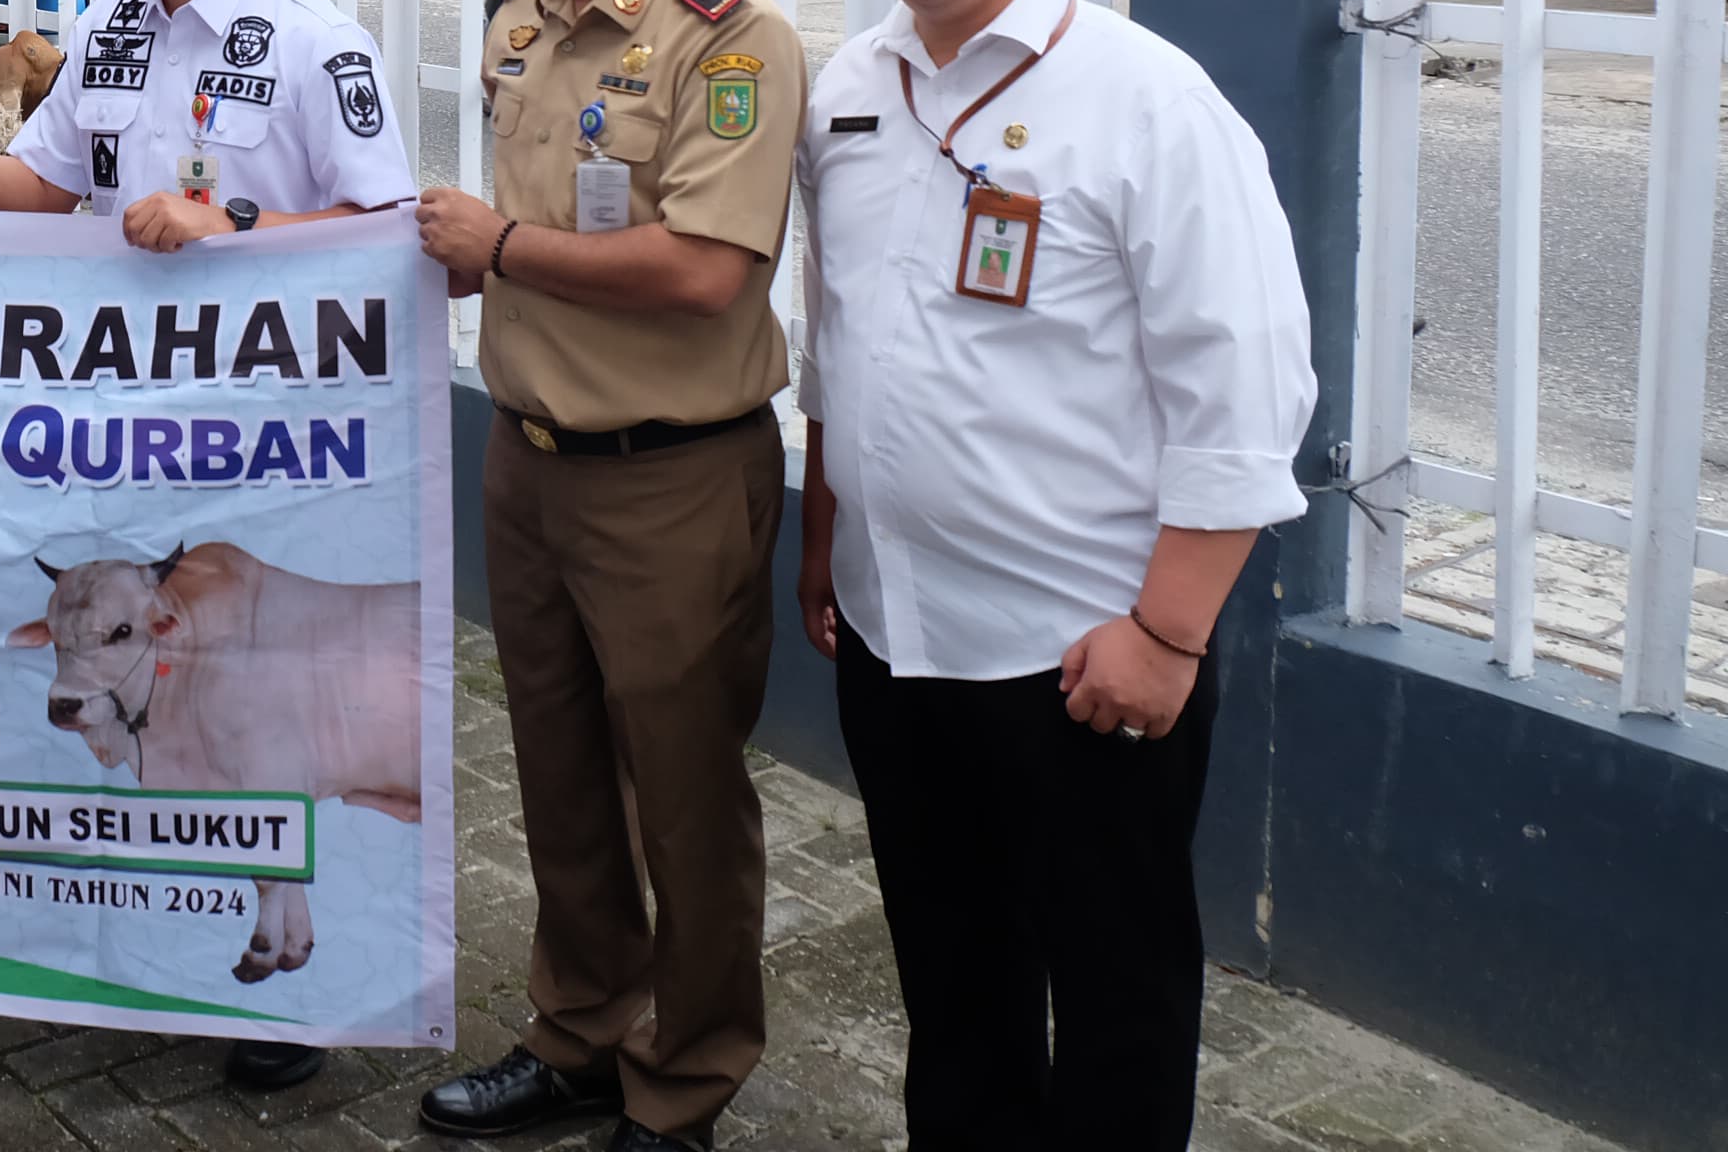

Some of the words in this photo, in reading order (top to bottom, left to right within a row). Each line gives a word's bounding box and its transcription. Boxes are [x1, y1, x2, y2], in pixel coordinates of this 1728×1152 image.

[85, 66, 141, 85] BOBY
[201, 75, 268, 99] KADIS
[0, 403, 367, 486] QURBAN
[69, 807, 131, 843] SEI
[150, 811, 289, 852] LUKUT
[48, 876, 151, 911] TAHUN
[164, 885, 247, 917] 2024
